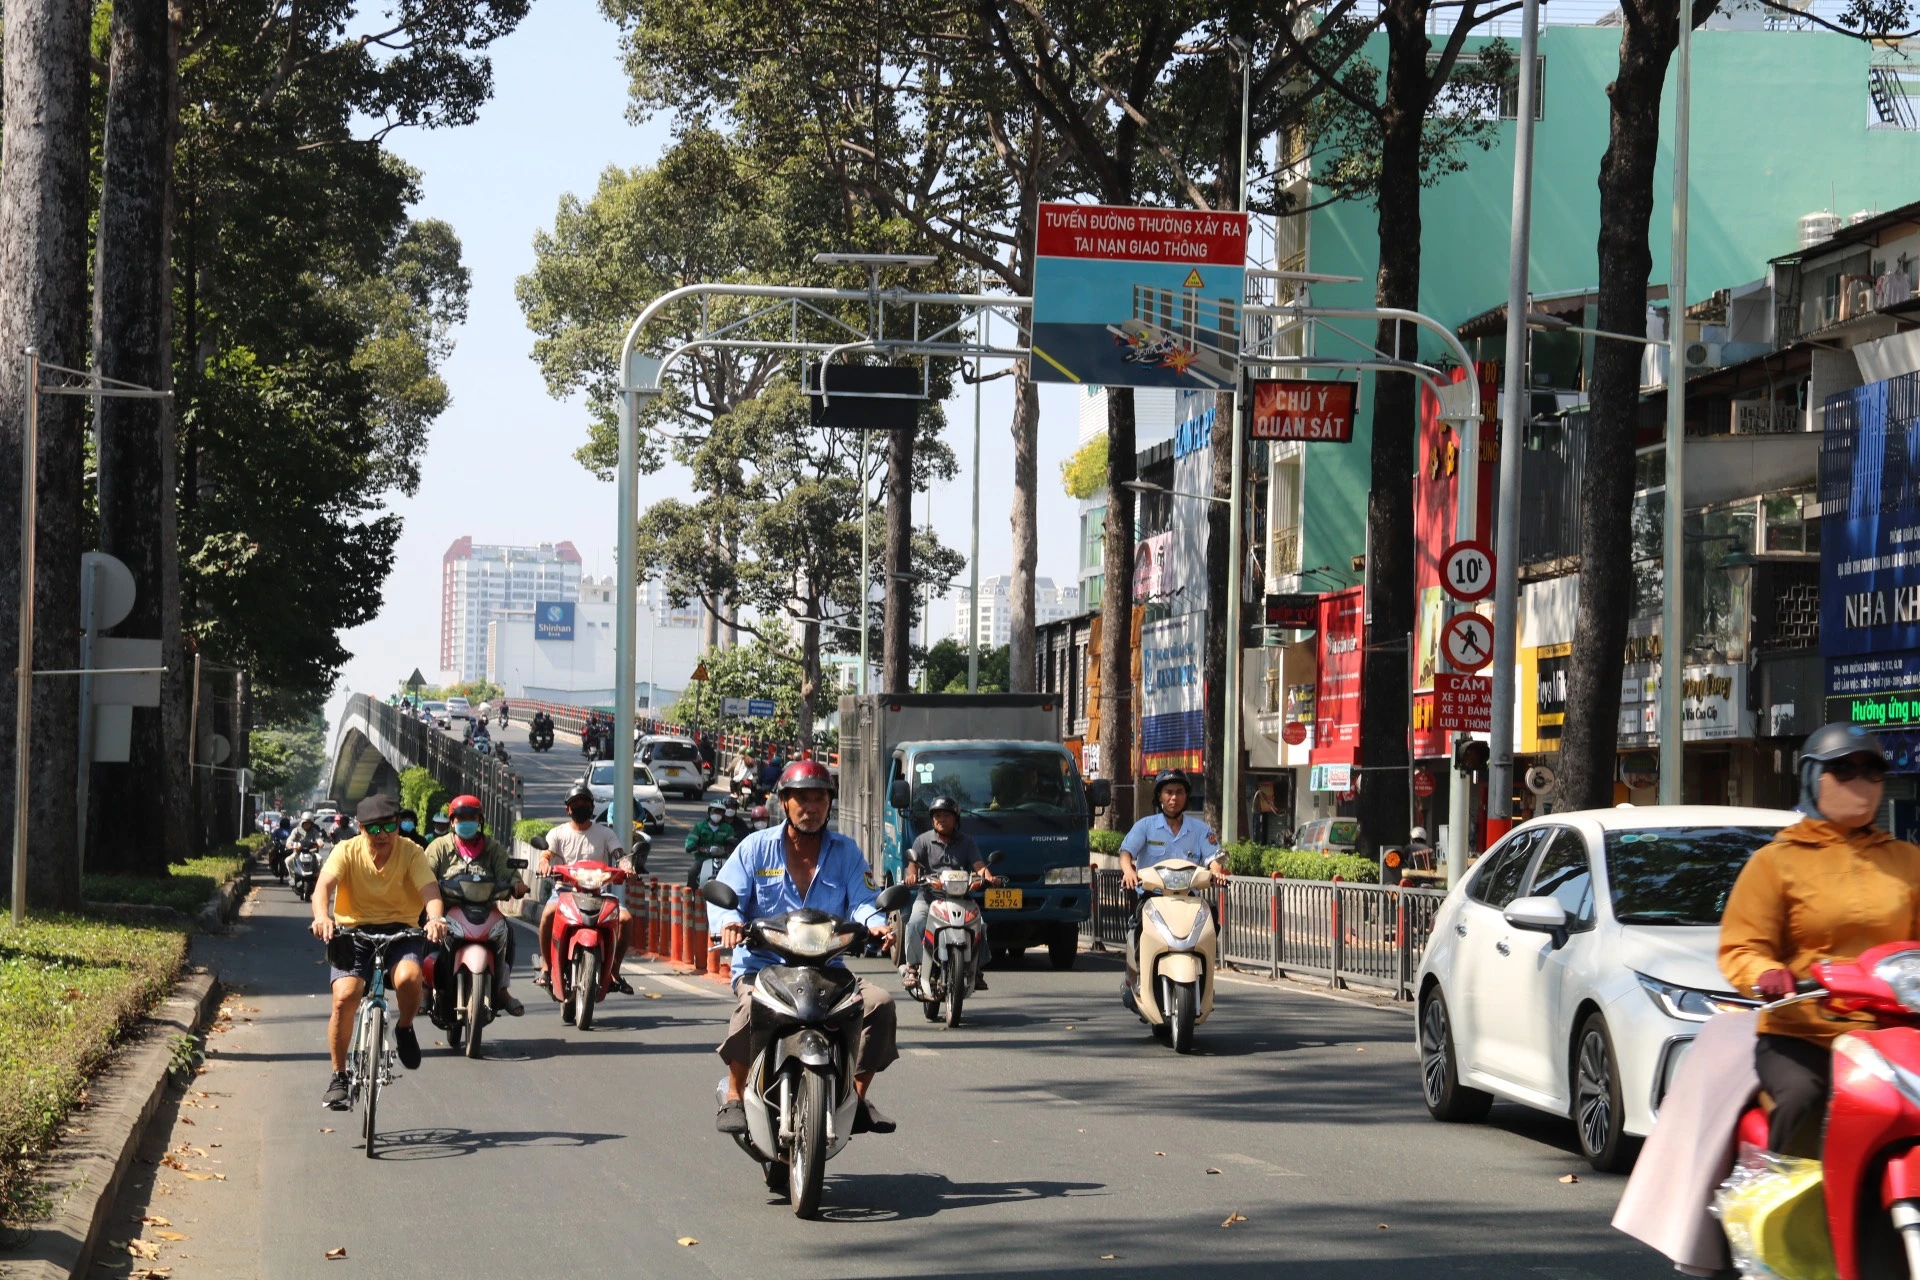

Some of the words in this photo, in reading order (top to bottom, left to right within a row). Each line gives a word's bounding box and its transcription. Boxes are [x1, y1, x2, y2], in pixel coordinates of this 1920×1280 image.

[1045, 209, 1088, 230] TUYẾN
[1090, 212, 1136, 232] ĐƯỜNG
[1138, 214, 1192, 235] THƯỜNG
[1194, 214, 1220, 237] XẢY
[1222, 221, 1241, 238] RA
[1074, 236, 1094, 252] TAI
[1097, 238, 1126, 257] NẠN
[1129, 238, 1160, 256] GIAO
[1164, 236, 1208, 258] THÔNG
[1276, 384, 1312, 412] CHÚ
[1316, 386, 1329, 412] Ý
[1256, 416, 1306, 440] QUAN
[1309, 412, 1345, 440] SÁT
[1845, 591, 1886, 629] NHA
[538, 623, 570, 632] Shinhan
[1450, 673, 1486, 691] CẤM
[1442, 692, 1454, 702] XE
[1458, 694, 1477, 704] ĐẠP
[1442, 704, 1454, 714] XE
[1458, 705, 1464, 714] 3
[1468, 704, 1492, 716] BÁNH
[1852, 697, 1886, 724] Hưởng
[1888, 695, 1908, 724] ứng
[1912, 700, 1920, 722] n
[1440, 717, 1458, 728] LƯU
[989, 898, 1018, 908] 255.74
[995, 890, 1012, 899] 51D
